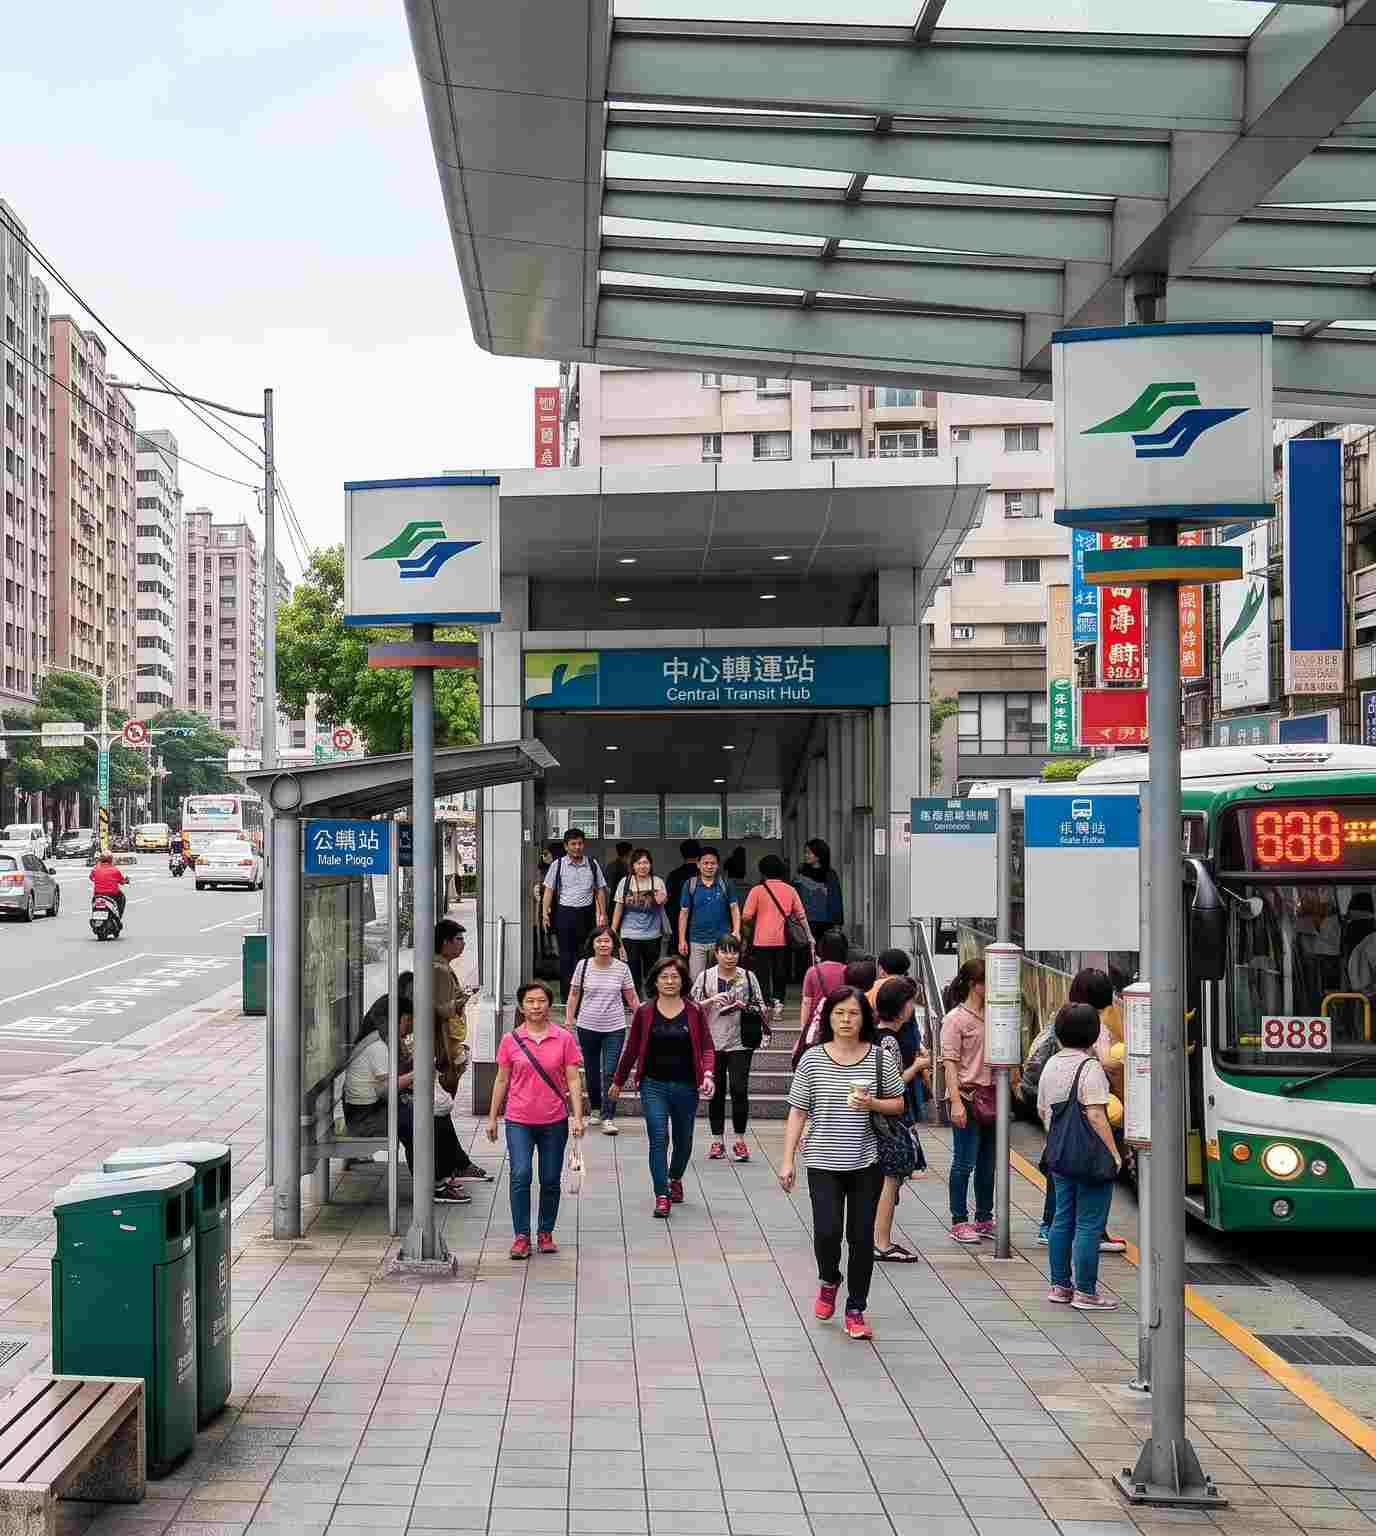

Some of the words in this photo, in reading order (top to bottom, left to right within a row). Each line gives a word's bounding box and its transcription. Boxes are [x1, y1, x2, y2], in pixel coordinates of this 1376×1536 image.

[663, 654, 816, 684] 中心轉運站
[666, 687, 720, 701] Central
[726, 687, 775, 700] Transit
[780, 686, 810, 700] Hub
[1265, 1019, 1328, 1049] 888
